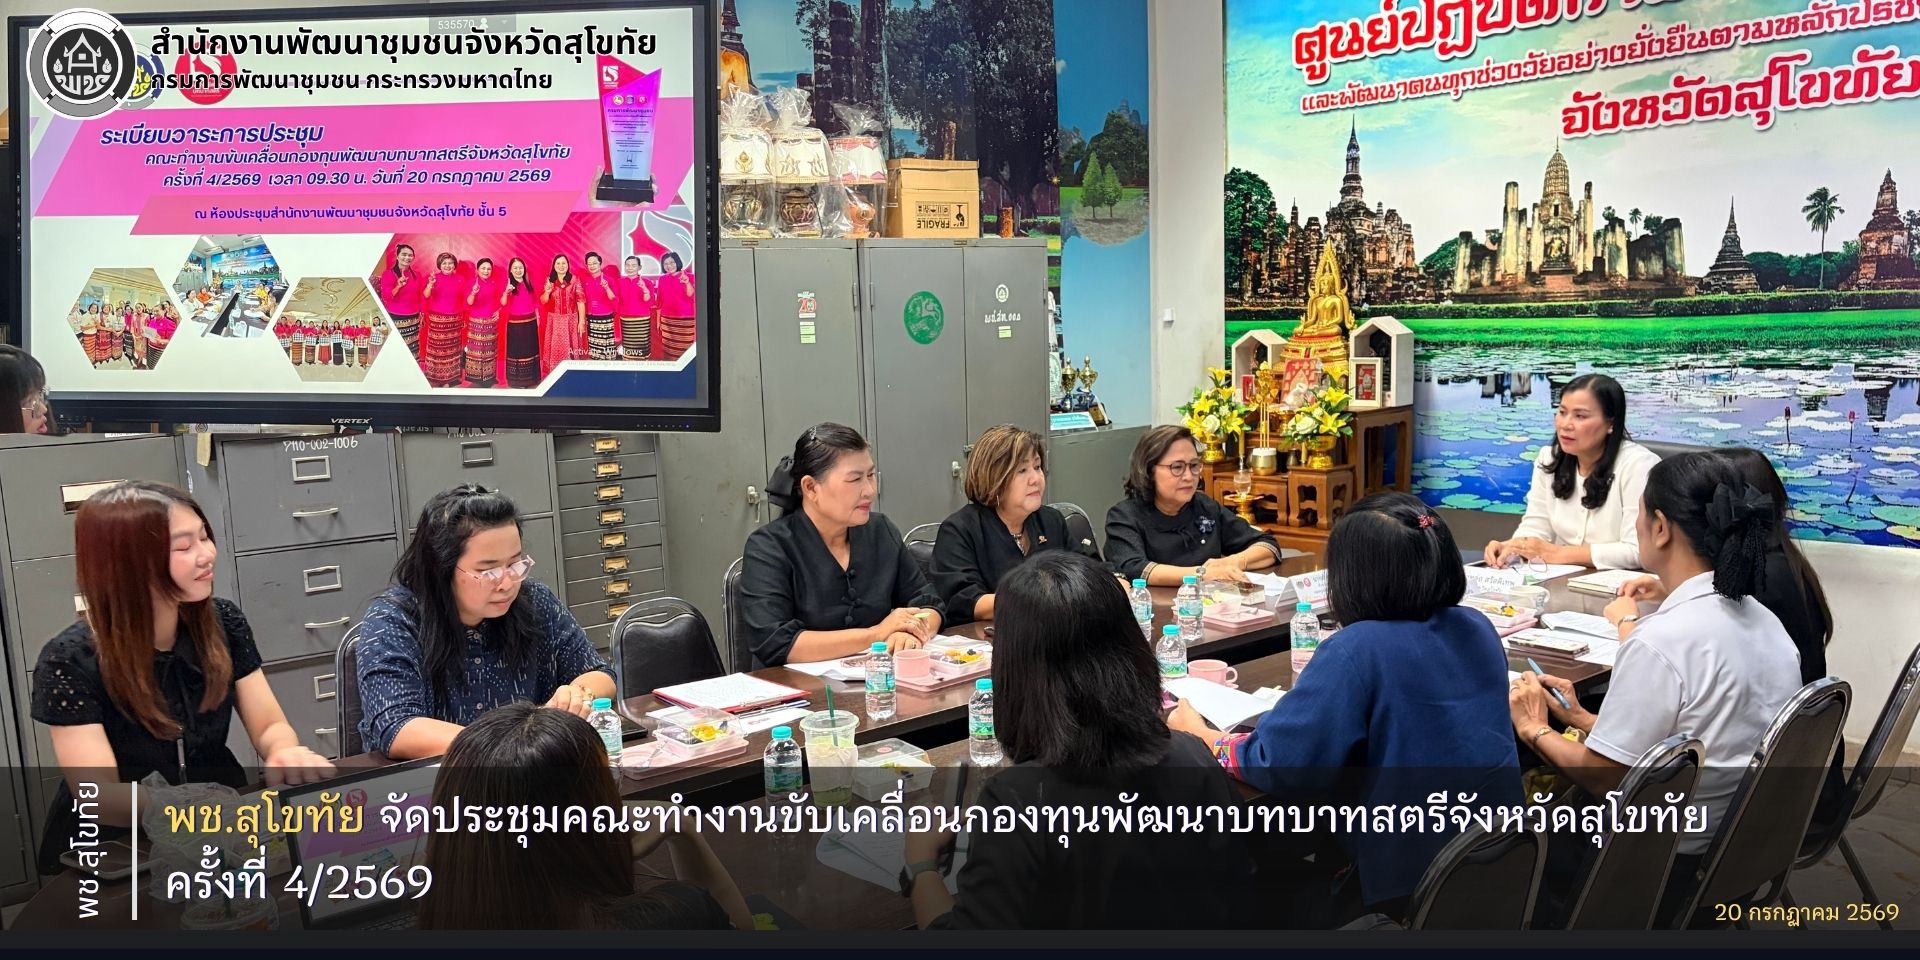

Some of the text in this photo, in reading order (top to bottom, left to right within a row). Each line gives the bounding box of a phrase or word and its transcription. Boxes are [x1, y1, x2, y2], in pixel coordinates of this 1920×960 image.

[438, 19, 475, 30] 535570
[1562, 49, 1920, 134] จังหวัดสุโขทัย
[100, 123, 323, 148] ระเบียบวาระการประชุม
[145, 143, 571, 167] คณะทำงานขับเคลื่อนกองทุนพัฒนาบทบาทสตรีจังหวัดสุโขทัย
[163, 167, 204, 187] ครั้งที่
[206, 173, 261, 186] 4/2569
[268, 174, 302, 185] เวลา
[306, 172, 349, 185] 09.30
[354, 173, 367, 184] น.
[372, 165, 406, 184] วันที่
[407, 171, 428, 183] 20
[508, 169, 551, 182] 2569
[195, 202, 507, 221] ณ ห้องประชุมสำนักงานพัฒนาชุมชนจังหวัดสุโขทัย ชั้น 5
[916, 219, 950, 229] FRAGILE
[567, 347, 599, 356] Activate
